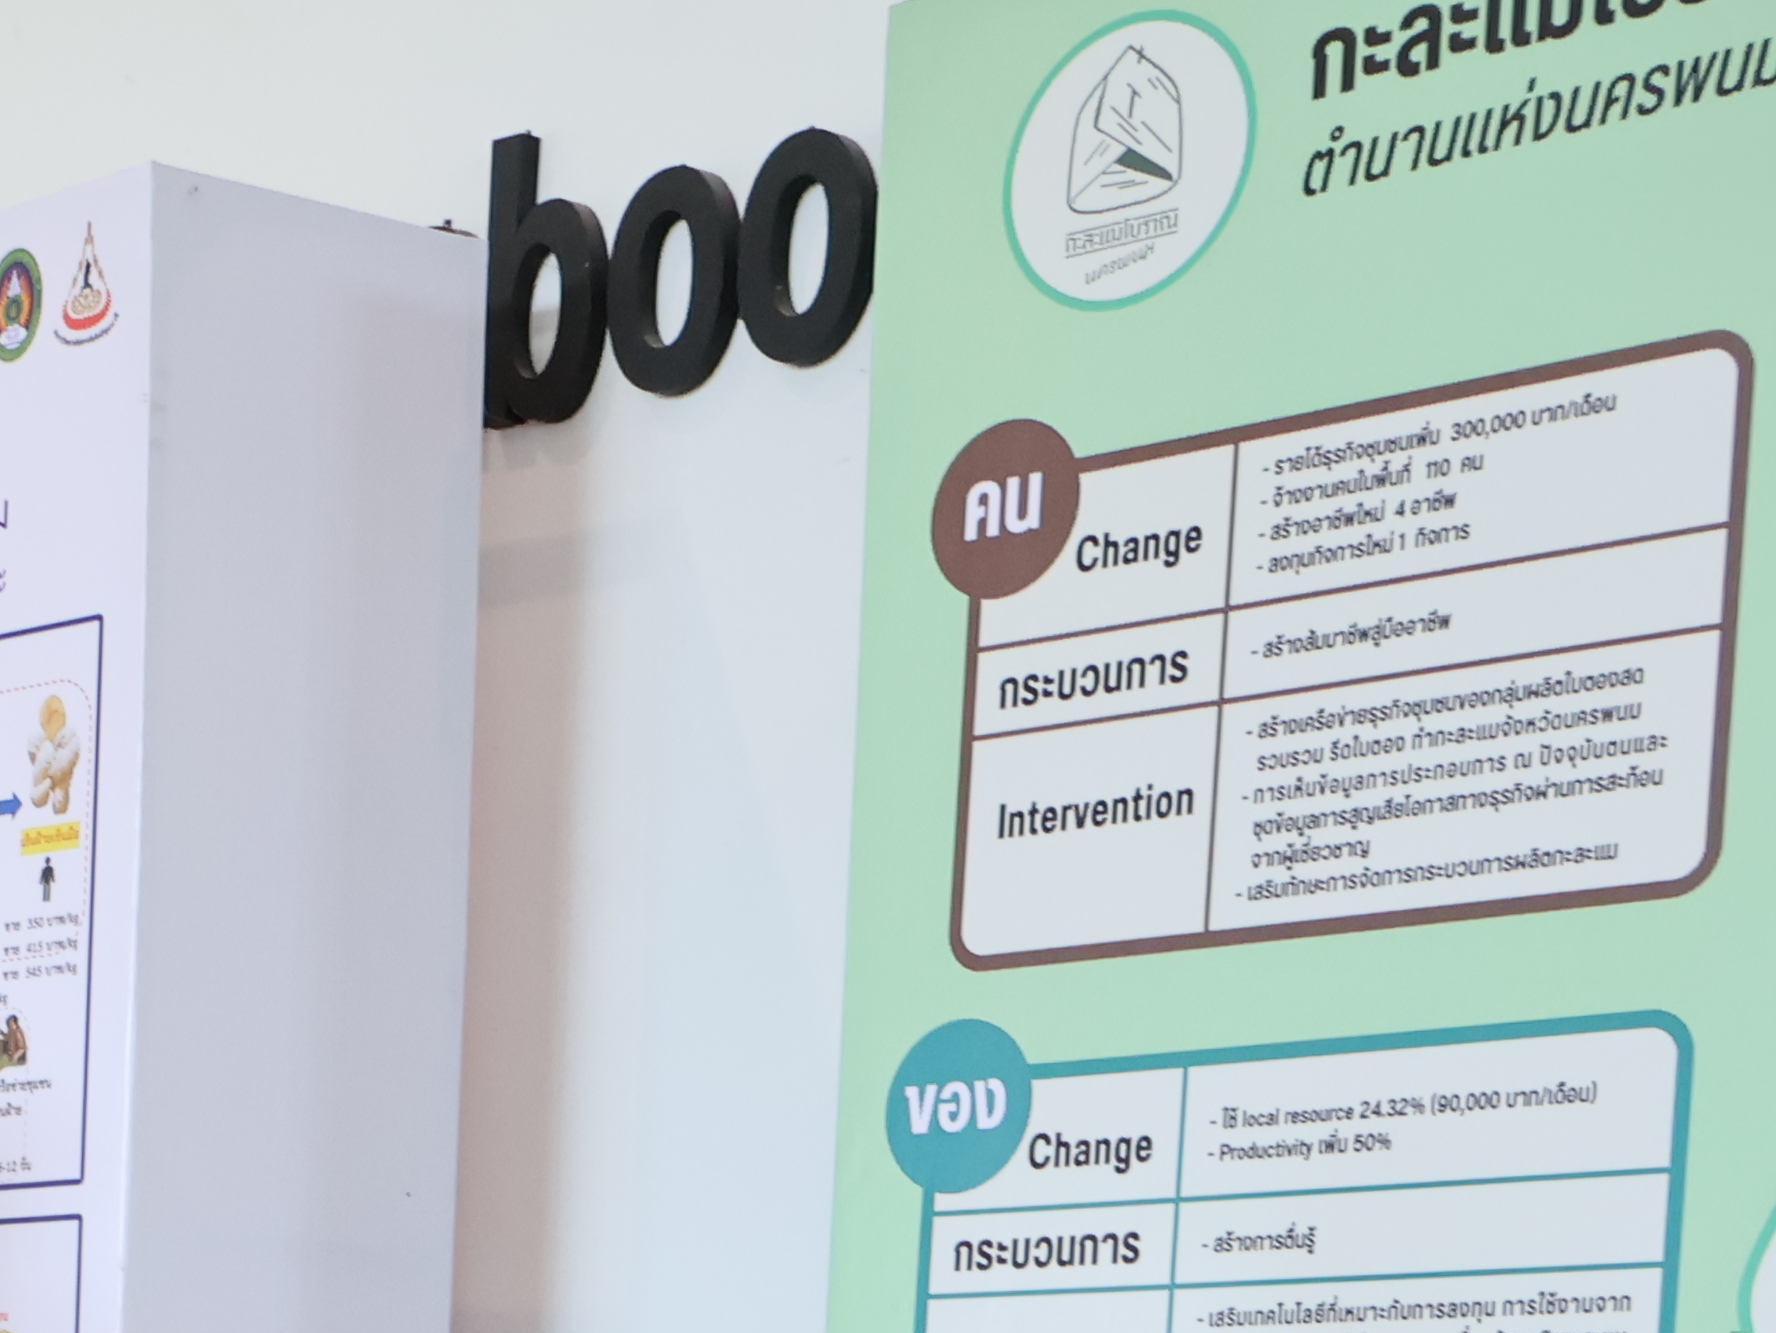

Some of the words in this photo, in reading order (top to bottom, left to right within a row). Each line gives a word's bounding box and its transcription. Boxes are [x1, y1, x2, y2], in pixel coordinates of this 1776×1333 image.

[1450, 412, 1527, 442] 300,000
[1531, 391, 1618, 427] บาท/เดือน
[1425, 458, 1451, 480] 110
[1460, 451, 1485, 474] คน
[964, 471, 1044, 542] คน
[1270, 501, 1385, 542] สร้างอาชีพใหม่
[1394, 499, 1406, 518] 4
[1410, 490, 1457, 516] อาชีพ
[1076, 524, 1204, 572] Change
[1415, 522, 1471, 550] กิจการ
[999, 650, 1190, 710] กระบวนการ
[1257, 747, 1324, 771] รวบรวม
[997, 783, 1195, 840] Intervention
[1251, 835, 1370, 871] จากผู้เชี่ยวชาญ
[904, 1077, 1007, 1135] ของ
[1242, 1107, 1279, 1128] local
[1284, 1106, 1355, 1125] resource
[1359, 1095, 1426, 1120] 24.32%
[1431, 1090, 1501, 1117] (90,000
[1505, 1081, 1598, 1108] บาท/เดือน)
[1028, 1132, 1154, 1175] Change
[1219, 1138, 1313, 1162] Productivity
[1353, 1132, 1392, 1154] 50%
[954, 1231, 1141, 1272] กระบวนการ
